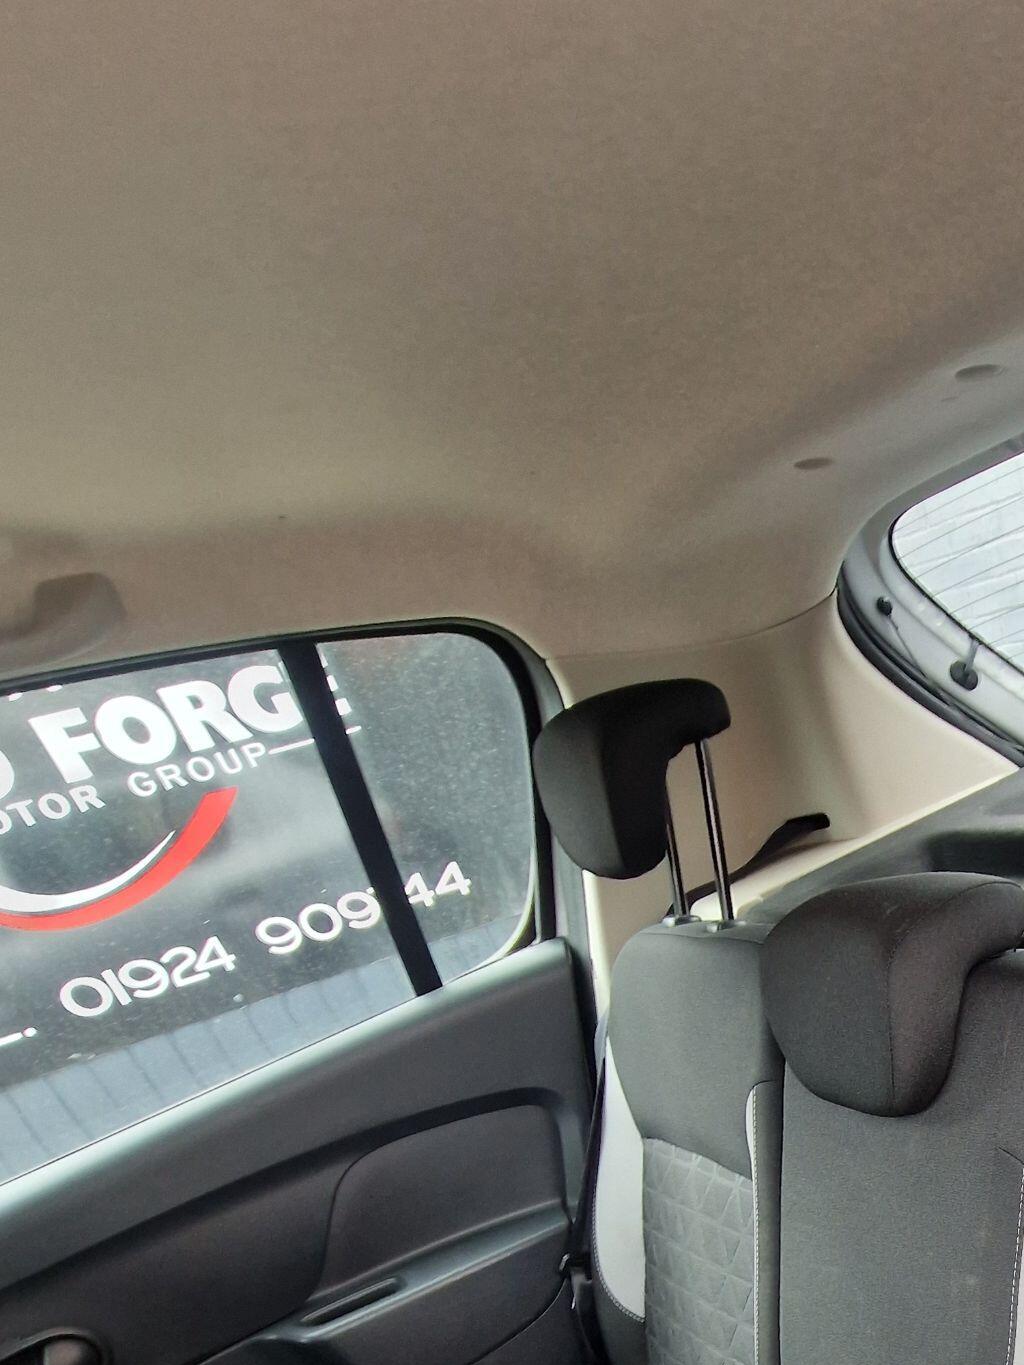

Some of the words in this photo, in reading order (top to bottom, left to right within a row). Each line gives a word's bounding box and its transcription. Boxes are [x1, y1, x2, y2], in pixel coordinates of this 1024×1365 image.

[127, 741, 267, 798] GROUP
[59, 935, 236, 1018] 01924
[254, 861, 472, 955] 90944
